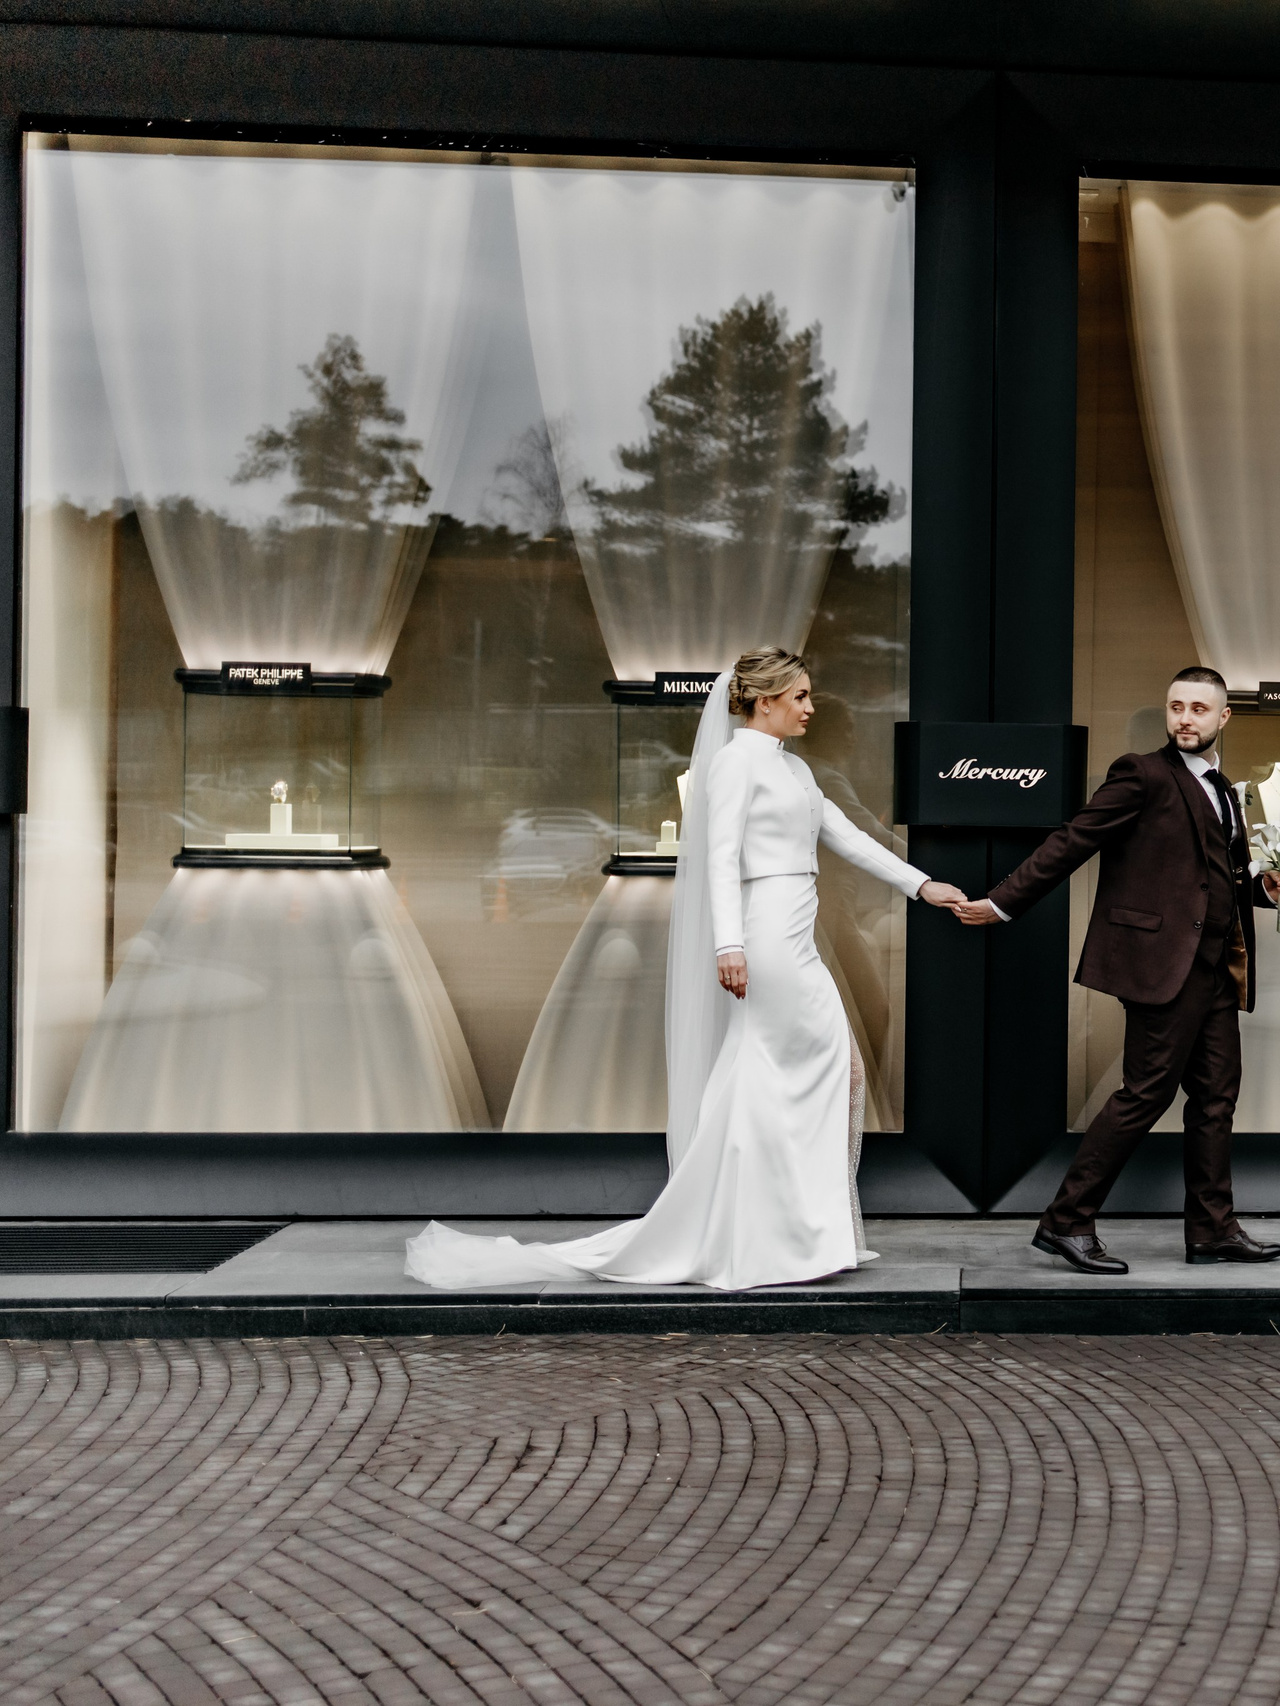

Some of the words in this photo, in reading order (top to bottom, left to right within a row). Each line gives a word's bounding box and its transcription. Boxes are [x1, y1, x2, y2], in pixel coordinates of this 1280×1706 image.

[229, 668, 259, 679] PATEK
[260, 668, 304, 679] PHILIPPE
[253, 678, 280, 686] GENEVE
[938, 758, 1048, 789] Mercury
